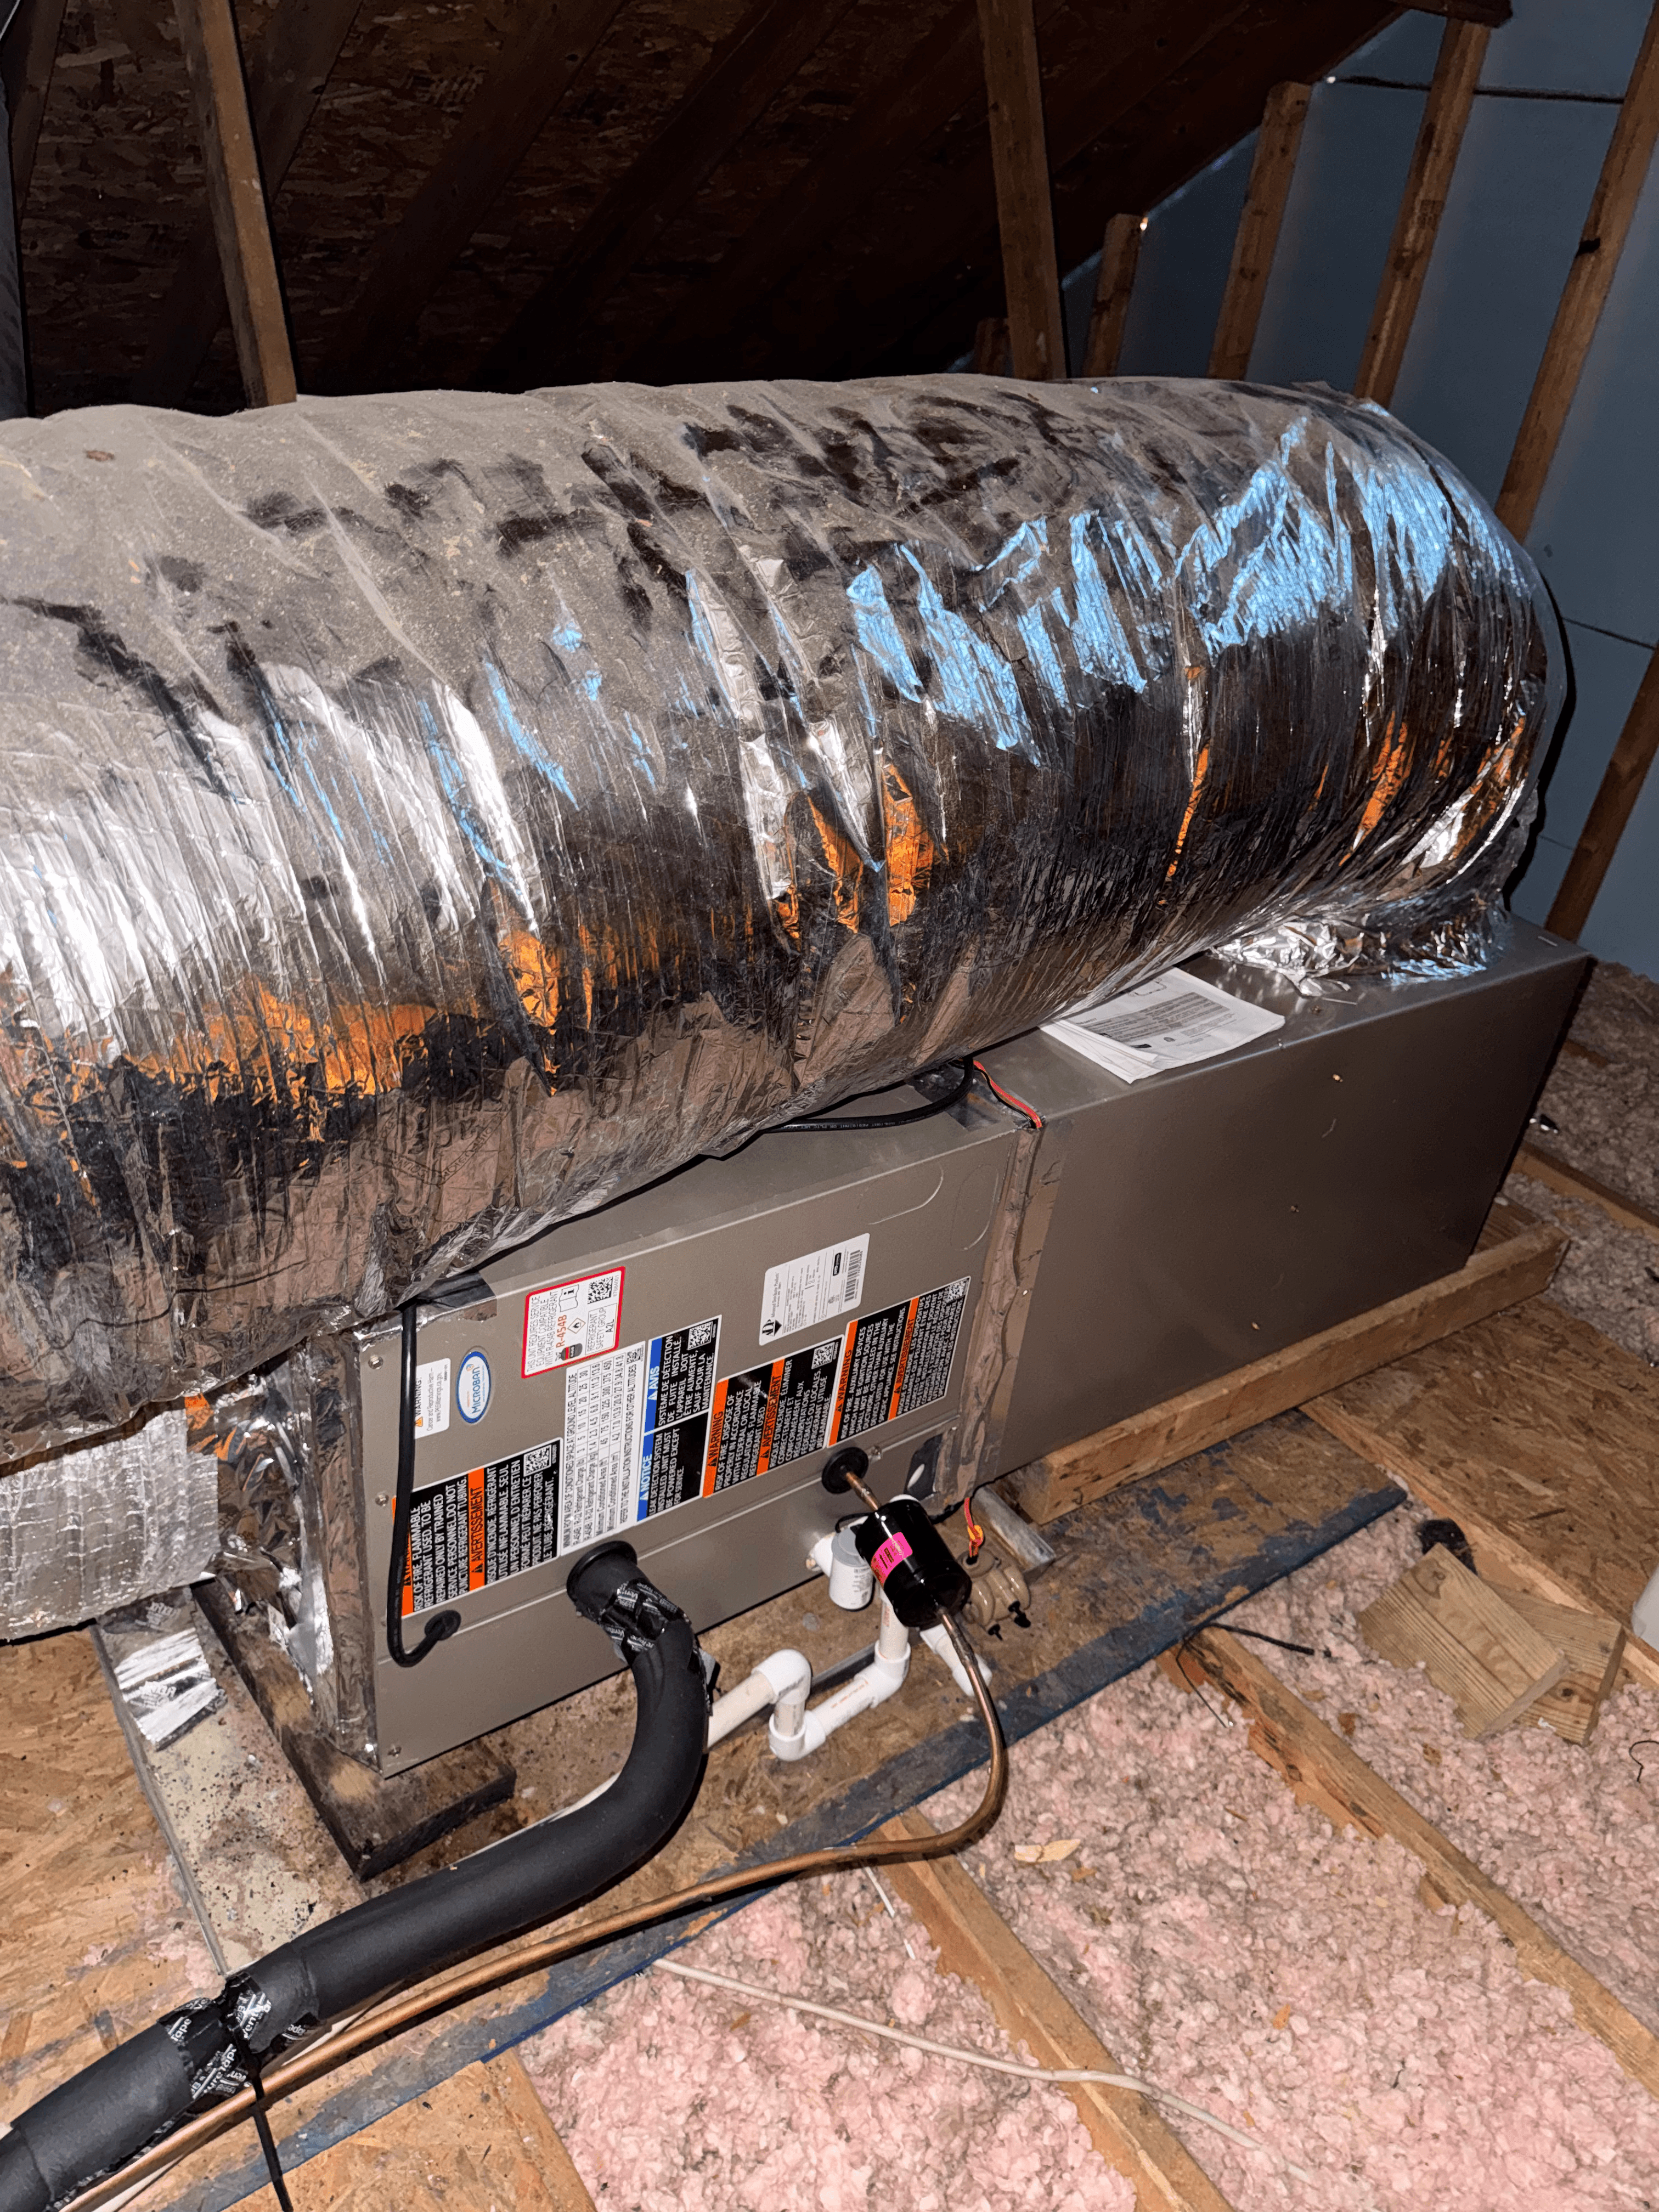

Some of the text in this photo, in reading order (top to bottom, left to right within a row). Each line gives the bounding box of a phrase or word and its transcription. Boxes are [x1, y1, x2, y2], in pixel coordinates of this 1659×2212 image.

[527, 1295, 540, 1372] THIS UNIT REQUIRES SERVICE
[536, 1299, 549, 1367] EQUIPMENT COMPATIBLE
[545, 1290, 557, 1367] WITH R-454B REFRIGERANT
[556, 1314, 567, 1348] R-454B
[587, 1312, 597, 1352] REFRIGERANT
[596, 1306, 606, 1350] SAFETY GROUP
[605, 1319, 614, 1333] A2L
[857, 1323, 874, 1387] IGNITION SOURCES
[864, 1320, 882, 1384] INSTALLED THE
[883, 1337, 892, 1355] WITH
[896, 1316, 914, 1385] AVERTISSEMENT
[591, 1363, 600, 1376] 13.6
[591, 1376, 599, 1389] 11.3
[602, 1372, 611, 1384] 375
[603, 1359, 611, 1372] 450
[627, 1363, 636, 1393] ALTITUDES
[648, 1364, 659, 1391] AVIS
[657, 1335, 673, 1426] SYSTÈME DE DÉTECTION
[667, 1336, 681, 1422] DE FUITE INSTALLÉ.
[675, 1352, 689, 1419] L'APPAREIL DOIT
[693, 1353, 706, 1413] SAUF POUR LA
[702, 1352, 714, 1409] MAINTENANCE.
[795, 1380, 804, 1398] AUX
[837, 1348, 851, 1402] WARNING
[848, 1356, 861, 1395] AUXILIARY
[855, 1325, 866, 1357] DEVICES
[870, 1369, 879, 1392] OTHER
[471, 1366, 480, 1413] MICROBAN
[566, 1372, 577, 1462] SPACE GROUND LEVEL ALTITUDE
[578, 1369, 588, 1430] 10 15 20 25 30
[590, 1390, 599, 1401] 9.1
[601, 1398, 610, 1410] 225
[683, 1392, 693, 1416] ÊTRE
[748, 1379, 761, 1429] FLAMMABLE
[761, 1373, 781, 1449] AVERTISSEMENT
[600, 1437, 608, 1446] 45
[601, 1424, 608, 1433] 75
[653, 1432, 663, 1461] SYSTEM
[708, 1409, 724, 1460] WARNING
[715, 1392, 735, 1490] RISK OF FIRE. DISPOSE OF
[723, 1389, 744, 1487] PROPERLY IN ACCORDANCE
[732, 1386, 752, 1483] WITH FEDERAL OR LOCAL
[748, 1426, 763, 1477] REFRIGERANT
[769, 1440, 780, 1468] RISQUE
[777, 1405, 793, 1465] CORRECTEMENT
[445, 1482, 455, 1503] NOT
[640, 1453, 652, 1492] NOTICE
[650, 1460, 661, 1498] DETECTION
[657, 1430, 671, 1511] INSTALLED. UNIT MUST
[665, 1426, 680, 1508] BE POWERED EXCEPT
[675, 1465, 684, 1492] SERVICE.
[457, 1476, 467, 1594] PUNCTURE REFRIGERANT TUBING.
[470, 1484, 482, 1564] AVERTISSEMENT
[485, 1465, 496, 1584] RISQUE D'INCENDIE. RÉFRIGÉRANT
[496, 1464, 508, 1580] UTILISÉ INFLAMMABLE. SEUL
[510, 1459, 520, 1575] UN PERSONNEL D'ENTRETIEN
[519, 1475, 531, 1571] FORMÉ PEUT RÉPARER CE
[532, 1471, 543, 1566] PRODUIT. NE PAS PERFORER
[542, 1476, 554, 1561] LE TUBE RÉFRIGÉRANT.
[410, 1505, 423, 1611] RISK OF FIRE. FLAMMABLE
[420, 1499, 433, 1607] REFRIGERANT USED. TO BE
[433, 1492, 445, 1603] REPAIRED ONLY BY TRAINED
[448, 1566, 458, 1599] SERVICE
